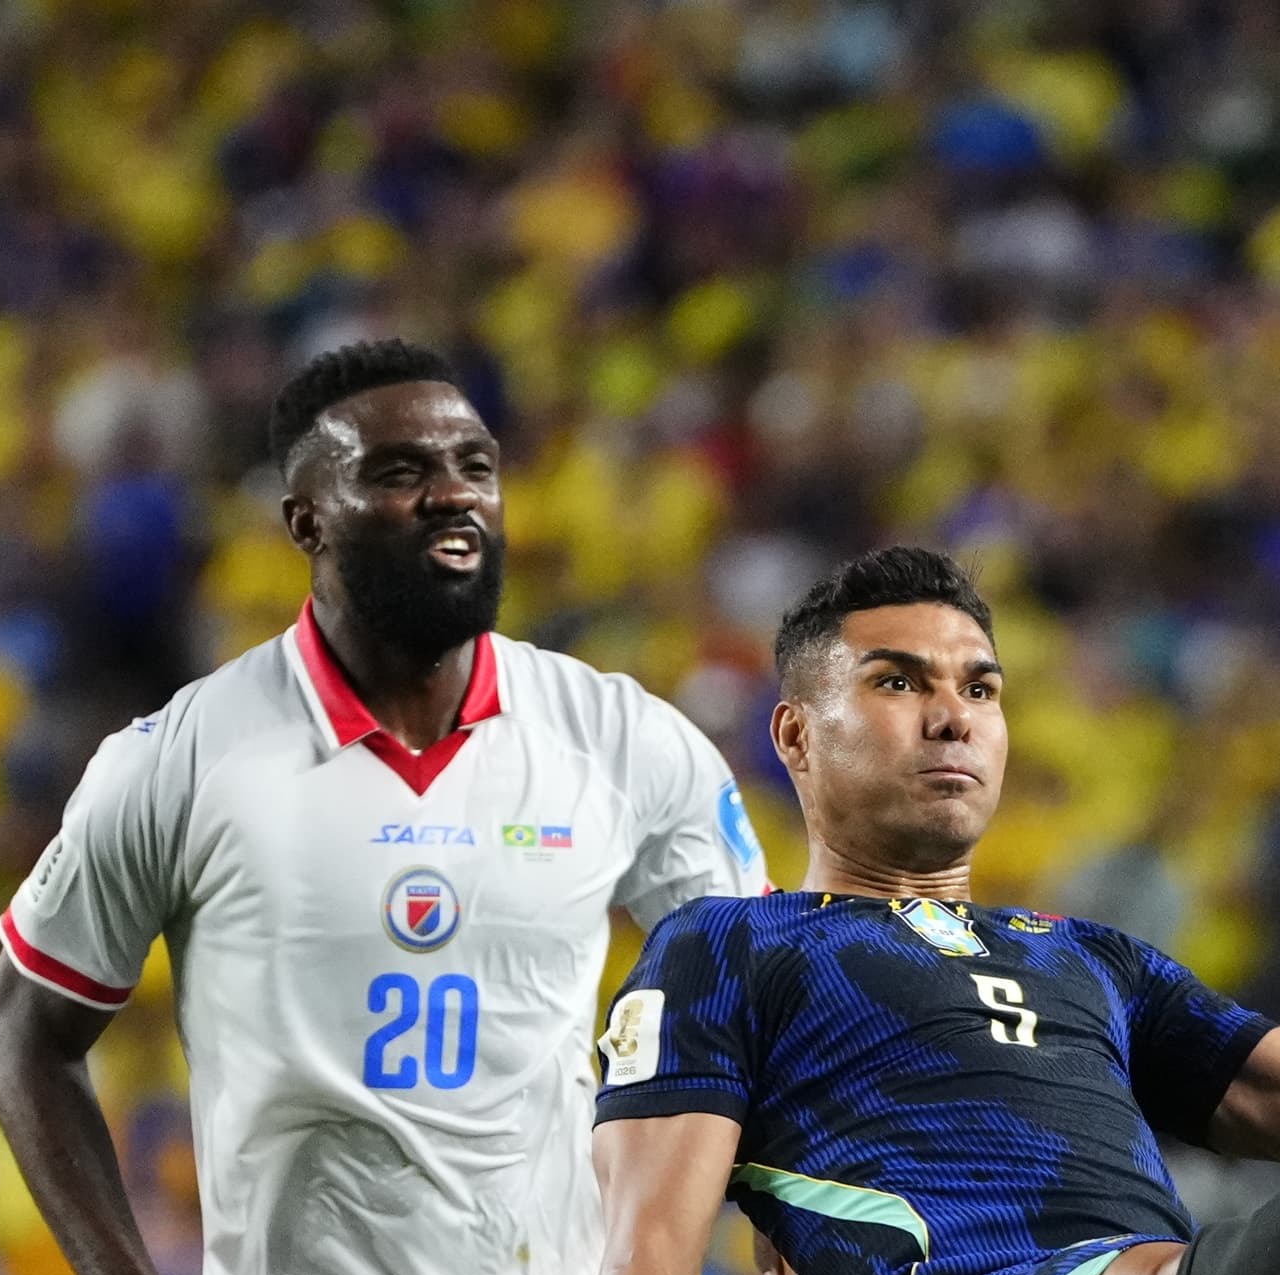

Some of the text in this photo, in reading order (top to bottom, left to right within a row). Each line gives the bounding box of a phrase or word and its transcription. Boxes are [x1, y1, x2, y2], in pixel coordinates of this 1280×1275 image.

[368, 824, 475, 846] SAETA
[362, 971, 479, 1090] 20
[970, 973, 1039, 1048] 5
